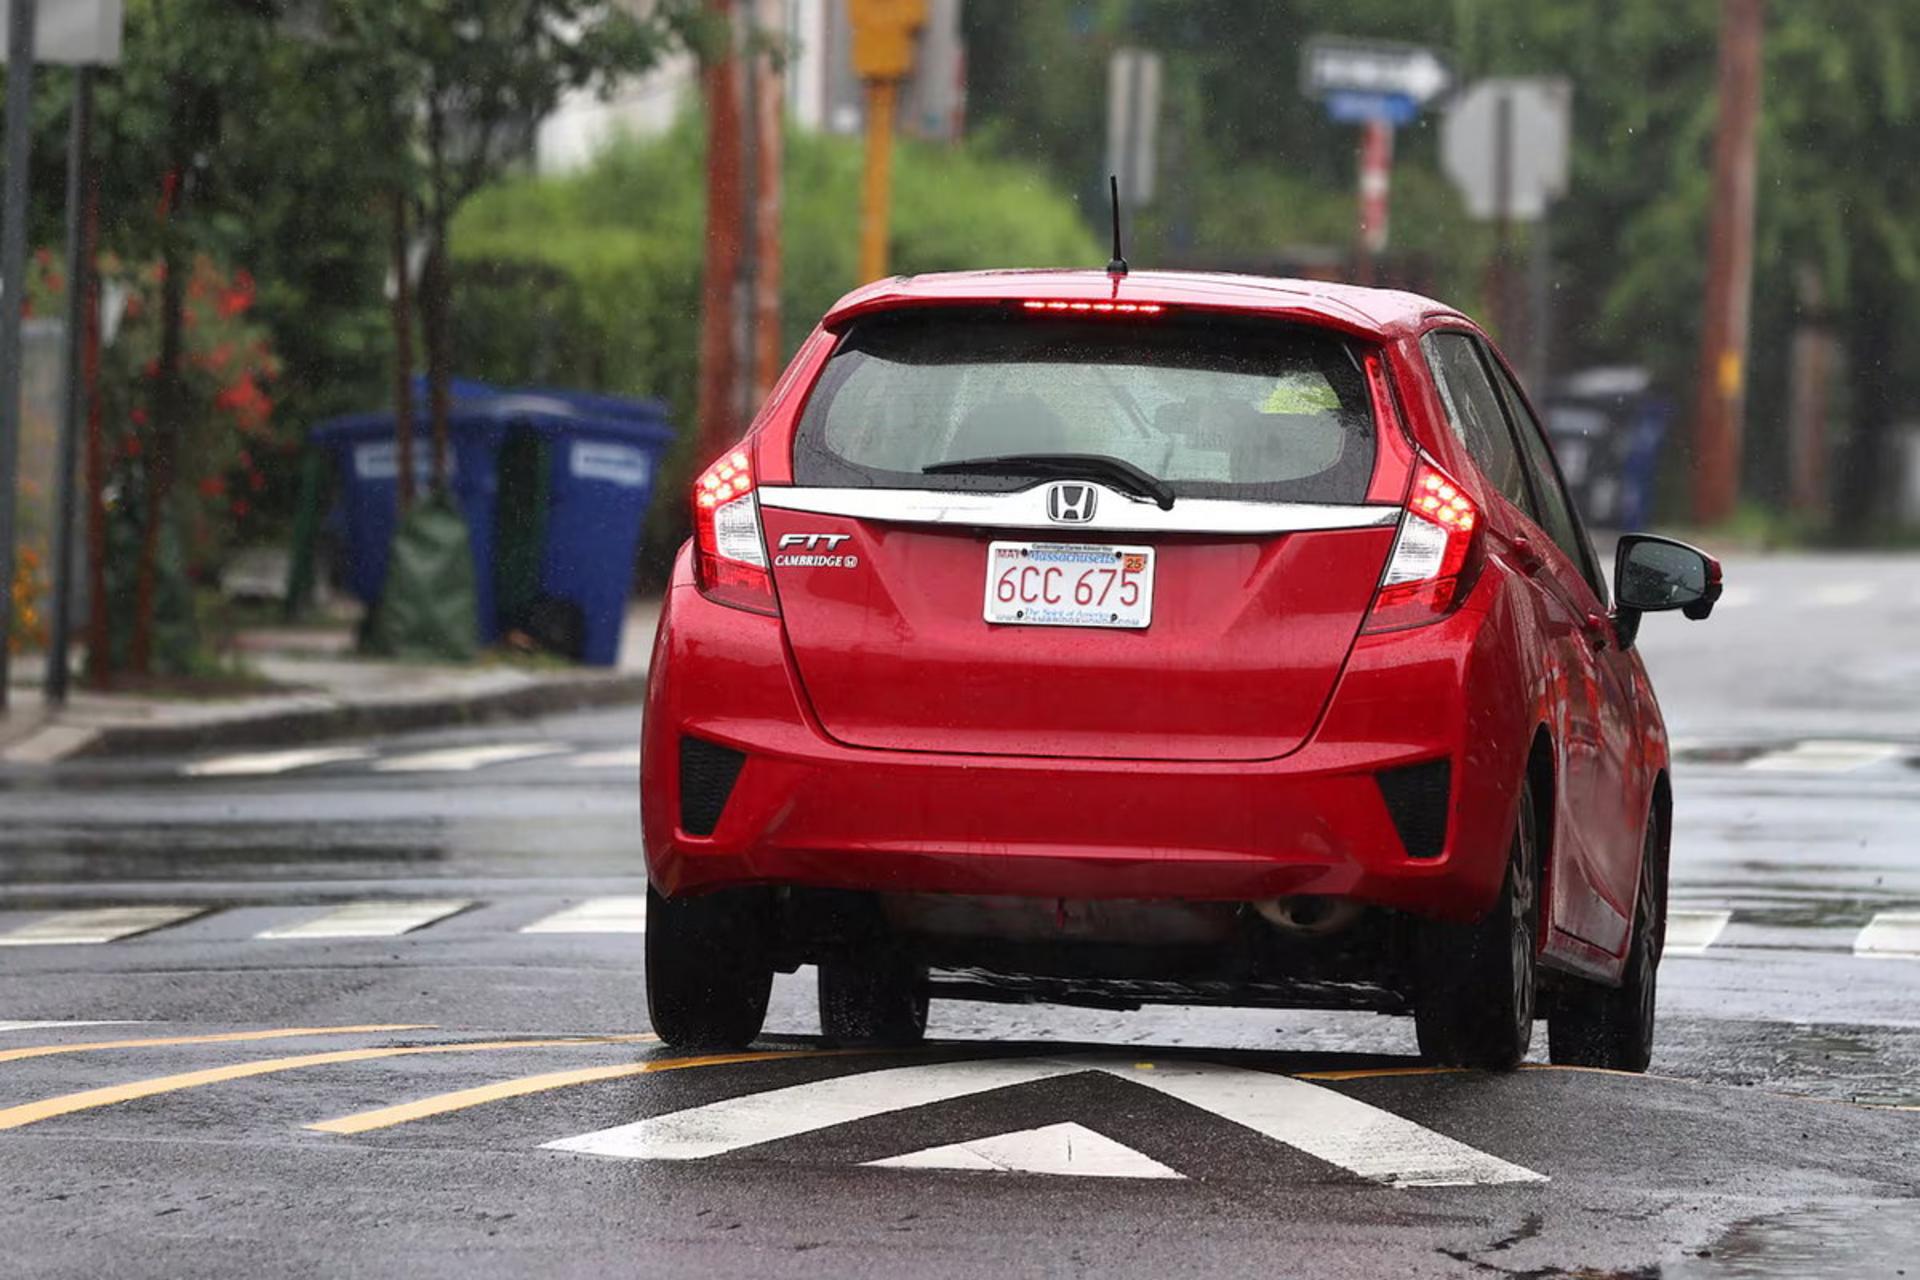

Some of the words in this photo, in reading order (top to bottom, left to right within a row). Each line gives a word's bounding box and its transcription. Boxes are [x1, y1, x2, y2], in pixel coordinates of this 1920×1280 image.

[778, 533, 851, 551] FIT
[775, 555, 842, 567] CAMBRIDGE
[1126, 558, 1143, 569] 25
[997, 565, 1063, 604] 6CC
[1074, 568, 1140, 607] 675
